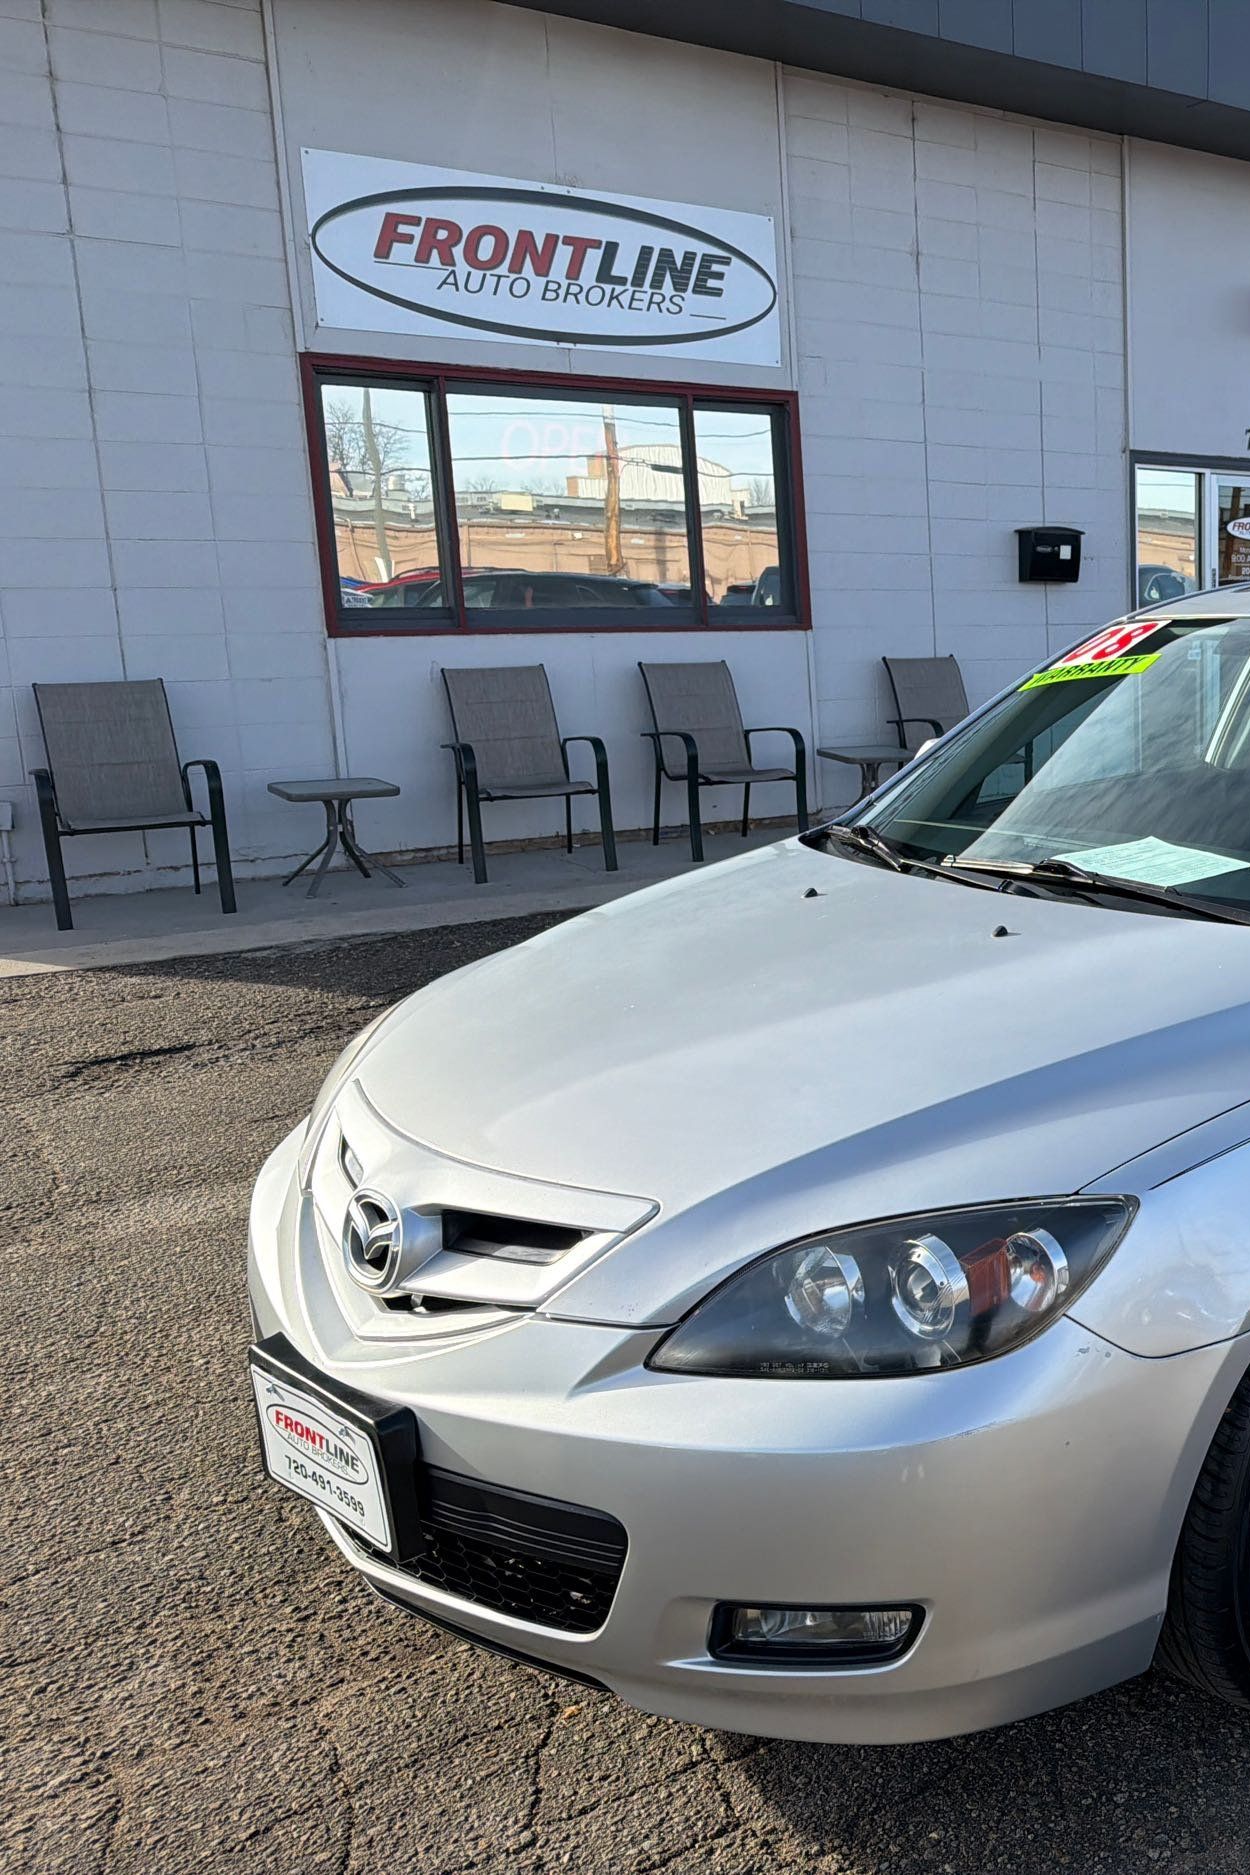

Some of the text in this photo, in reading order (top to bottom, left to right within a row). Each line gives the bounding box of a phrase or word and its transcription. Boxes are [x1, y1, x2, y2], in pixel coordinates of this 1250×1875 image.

[374, 212, 732, 297] FRONTLINE
[436, 268, 685, 315] AUTO BROKERS
[1034, 656, 1144, 684] WARRANTY
[275, 1409, 360, 1475] FRONTLINE
[287, 1432, 349, 1476] AUTO BROKERS
[284, 1455, 365, 1518] 720-491-3599
